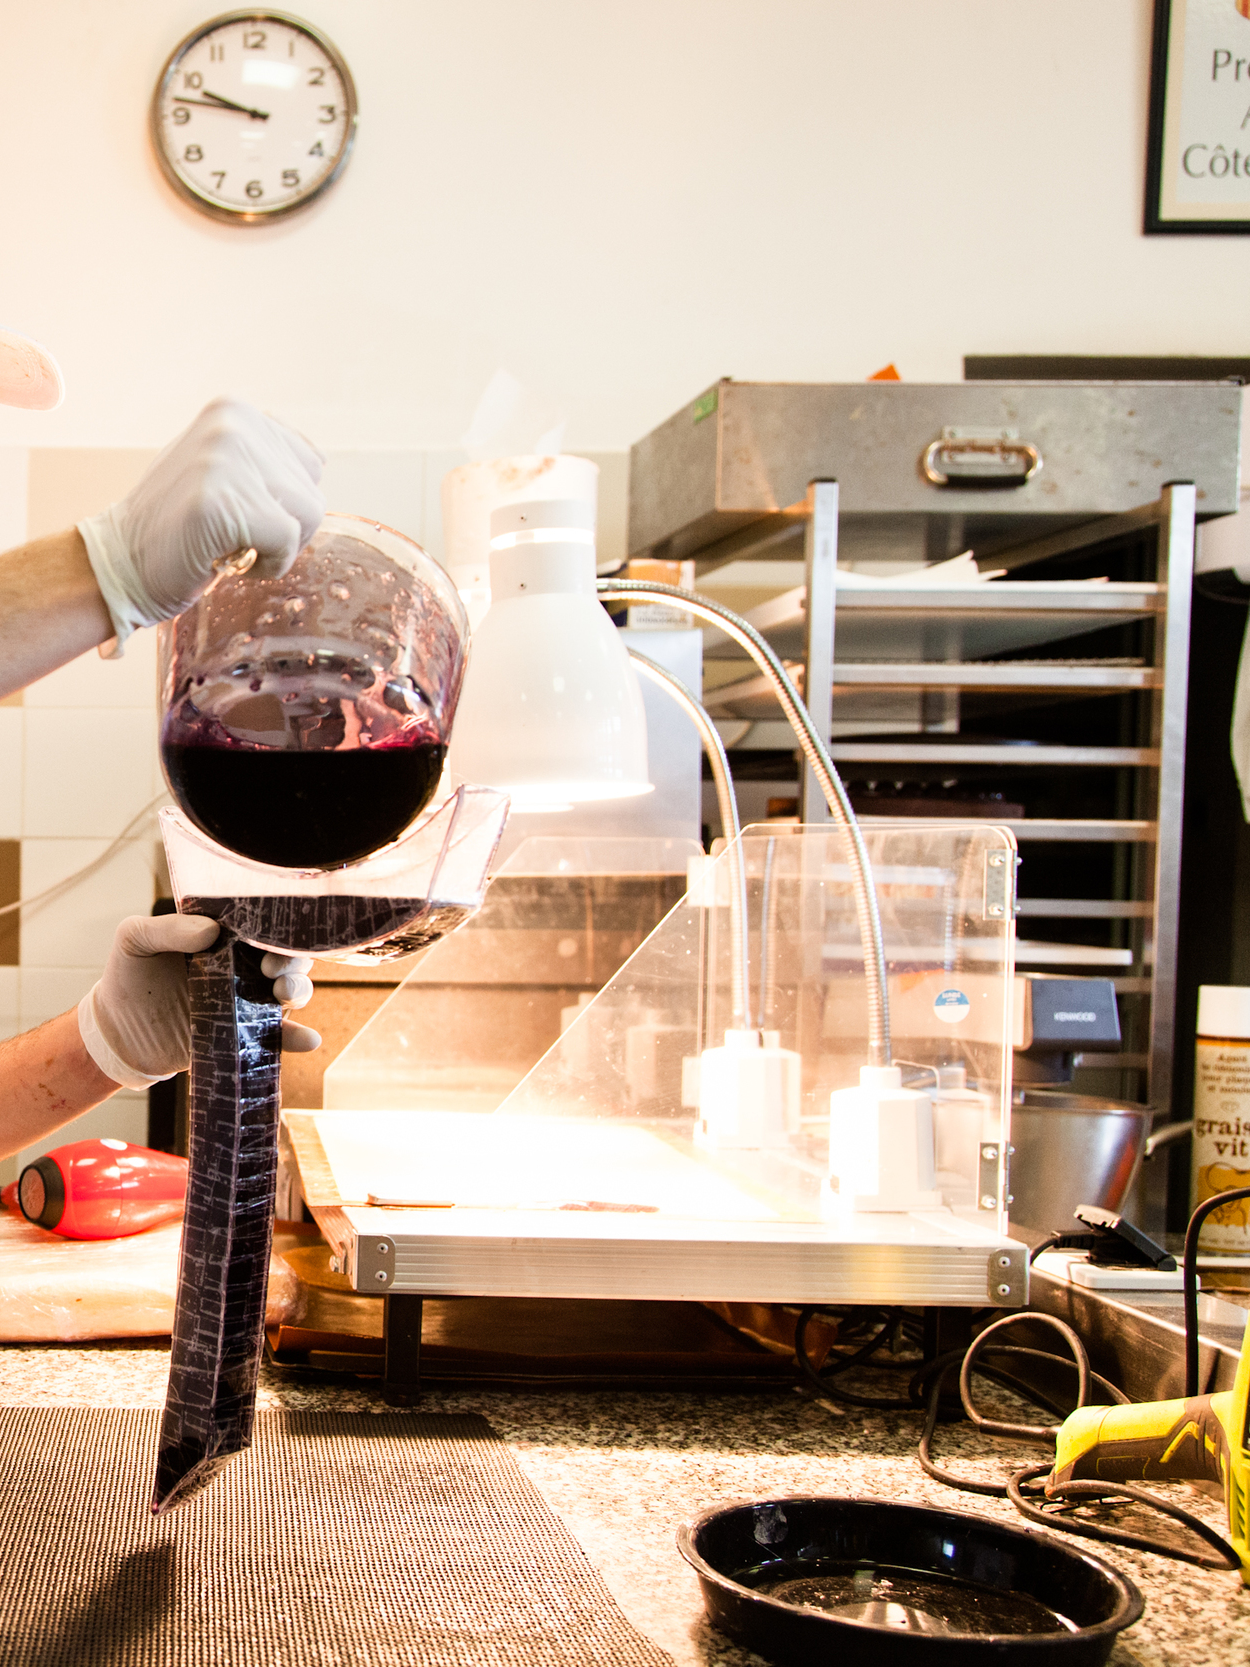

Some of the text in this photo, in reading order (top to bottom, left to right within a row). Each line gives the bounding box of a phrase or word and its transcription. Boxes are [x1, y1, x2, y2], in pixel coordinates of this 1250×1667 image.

[242, 31, 267, 50] 12
[288, 41, 296, 58] 1
[210, 43, 225, 62] 11
[1212, 48, 1250, 81] Pr
[183, 71, 203, 90] 10
[308, 67, 325, 86] 2
[172, 107, 191, 125] 9
[318, 105, 336, 124] 3
[184, 144, 204, 163] 8
[308, 140, 324, 158] 4
[210, 170, 227, 190] 7
[281, 169, 300, 188] 5
[245, 180, 264, 199] 6
[1053, 1011, 1097, 1023] KENWOOD
[1196, 1117, 1250, 1138] grais
[1213, 1137, 1249, 1157] vit
